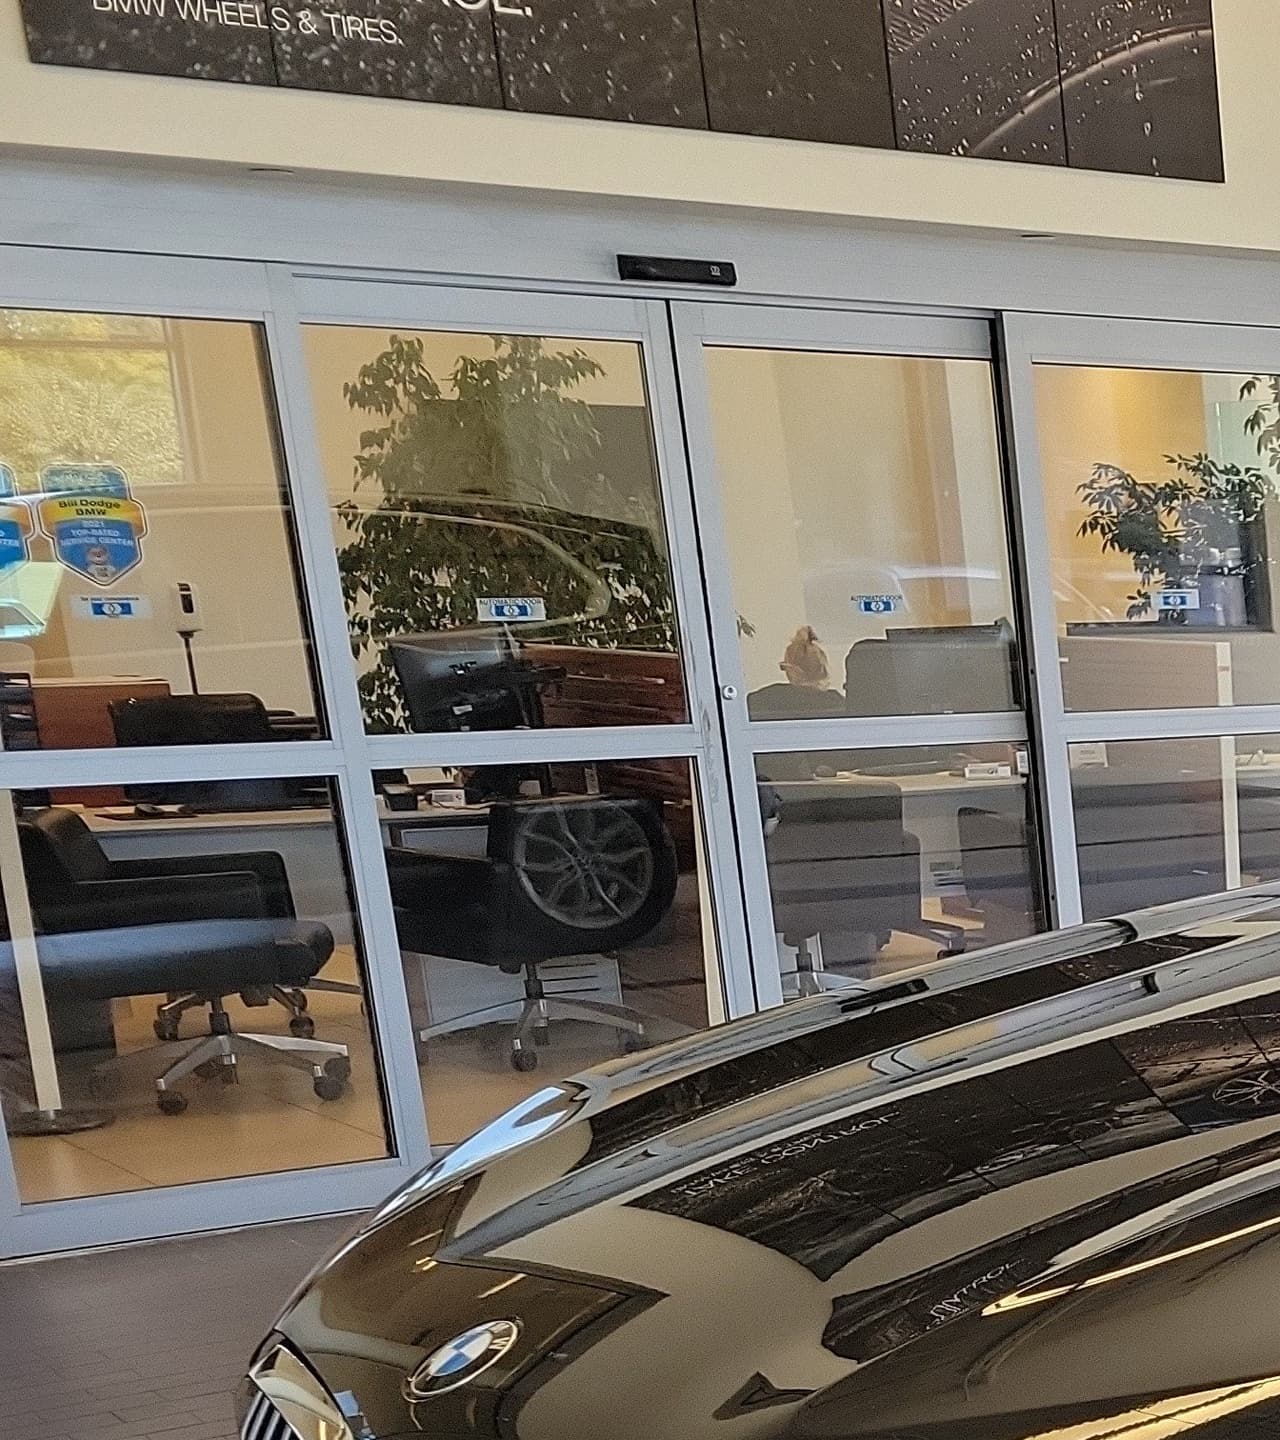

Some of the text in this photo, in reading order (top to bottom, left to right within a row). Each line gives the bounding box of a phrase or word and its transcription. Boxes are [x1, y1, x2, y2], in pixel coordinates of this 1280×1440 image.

[175, 0, 291, 31] WHEELS
[299, 10, 319, 35] &
[321, 12, 405, 46] TIRES.
[58, 499, 120, 509] Bill Dodge
